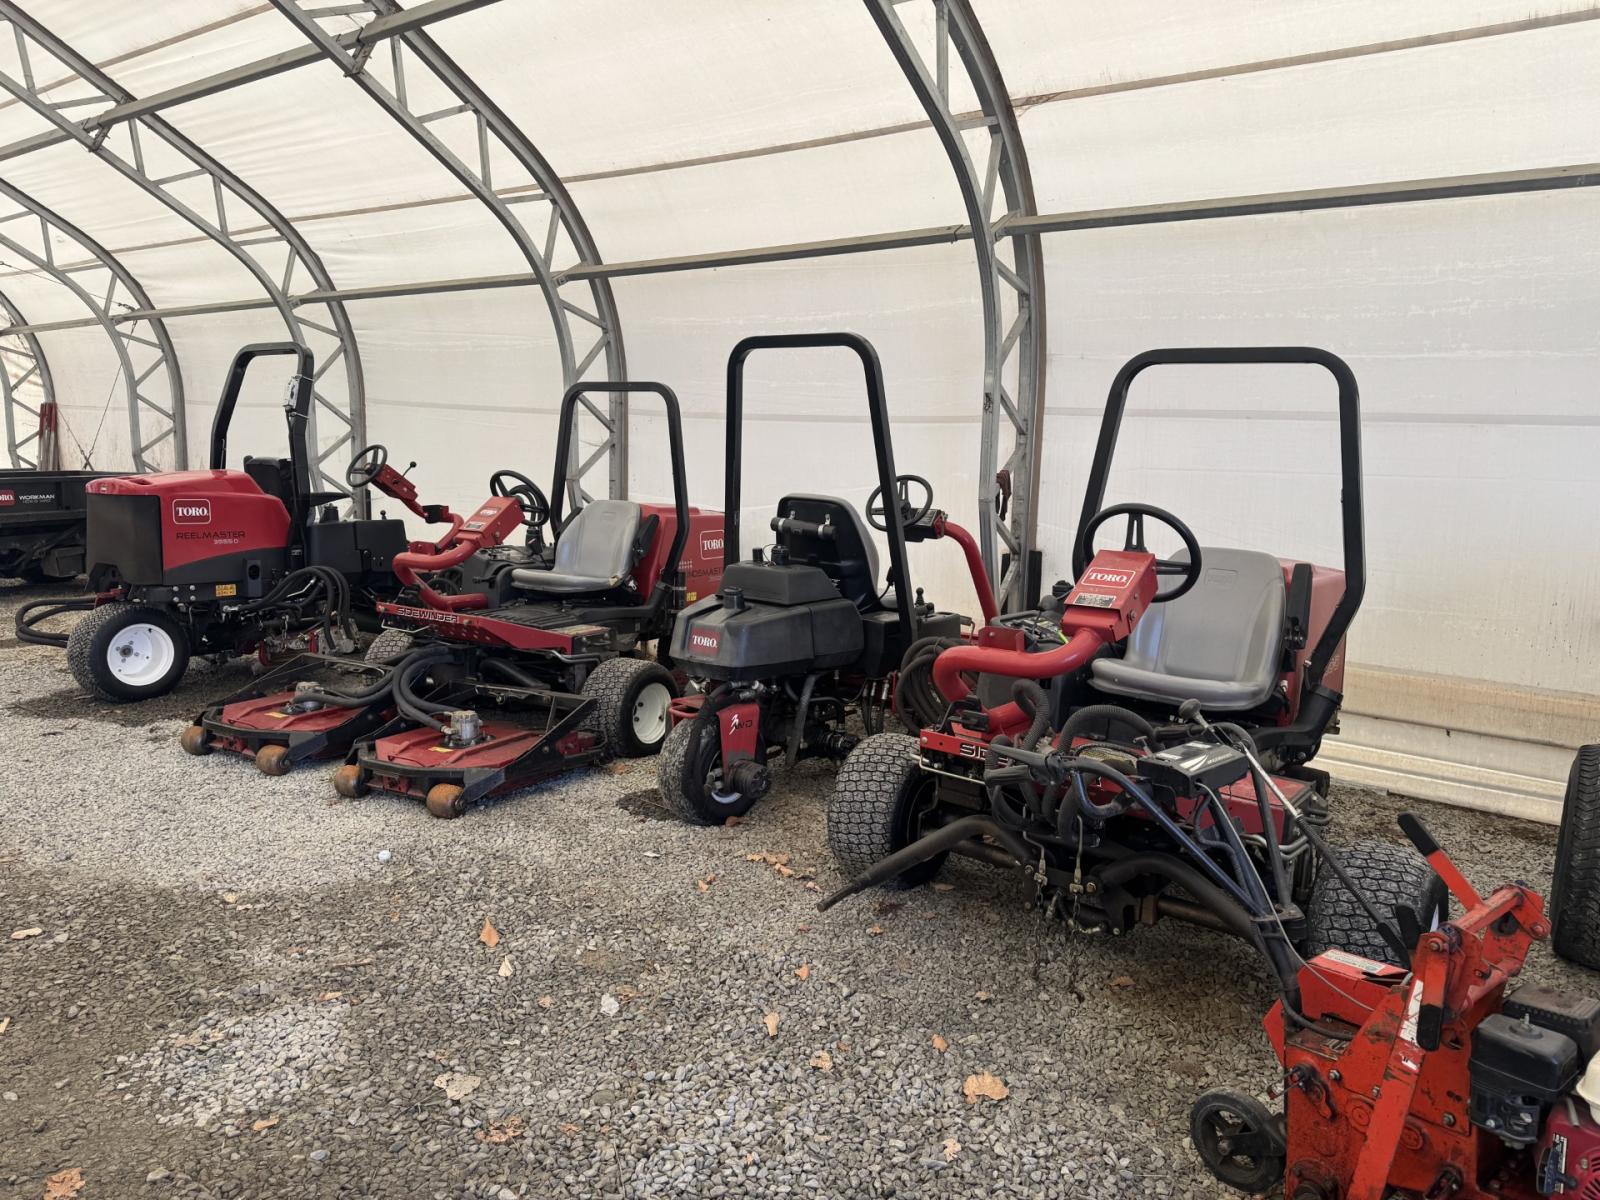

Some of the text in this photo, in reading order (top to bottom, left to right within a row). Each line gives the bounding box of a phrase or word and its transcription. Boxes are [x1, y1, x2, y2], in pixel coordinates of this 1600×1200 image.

[176, 507, 208, 517] TORO
[176, 530, 246, 540] REELMASTER
[703, 538, 724, 550] TORO
[1089, 572, 1127, 583] TORO
[397, 608, 459, 623] SIDEWINDER
[692, 635, 717, 648] TORO
